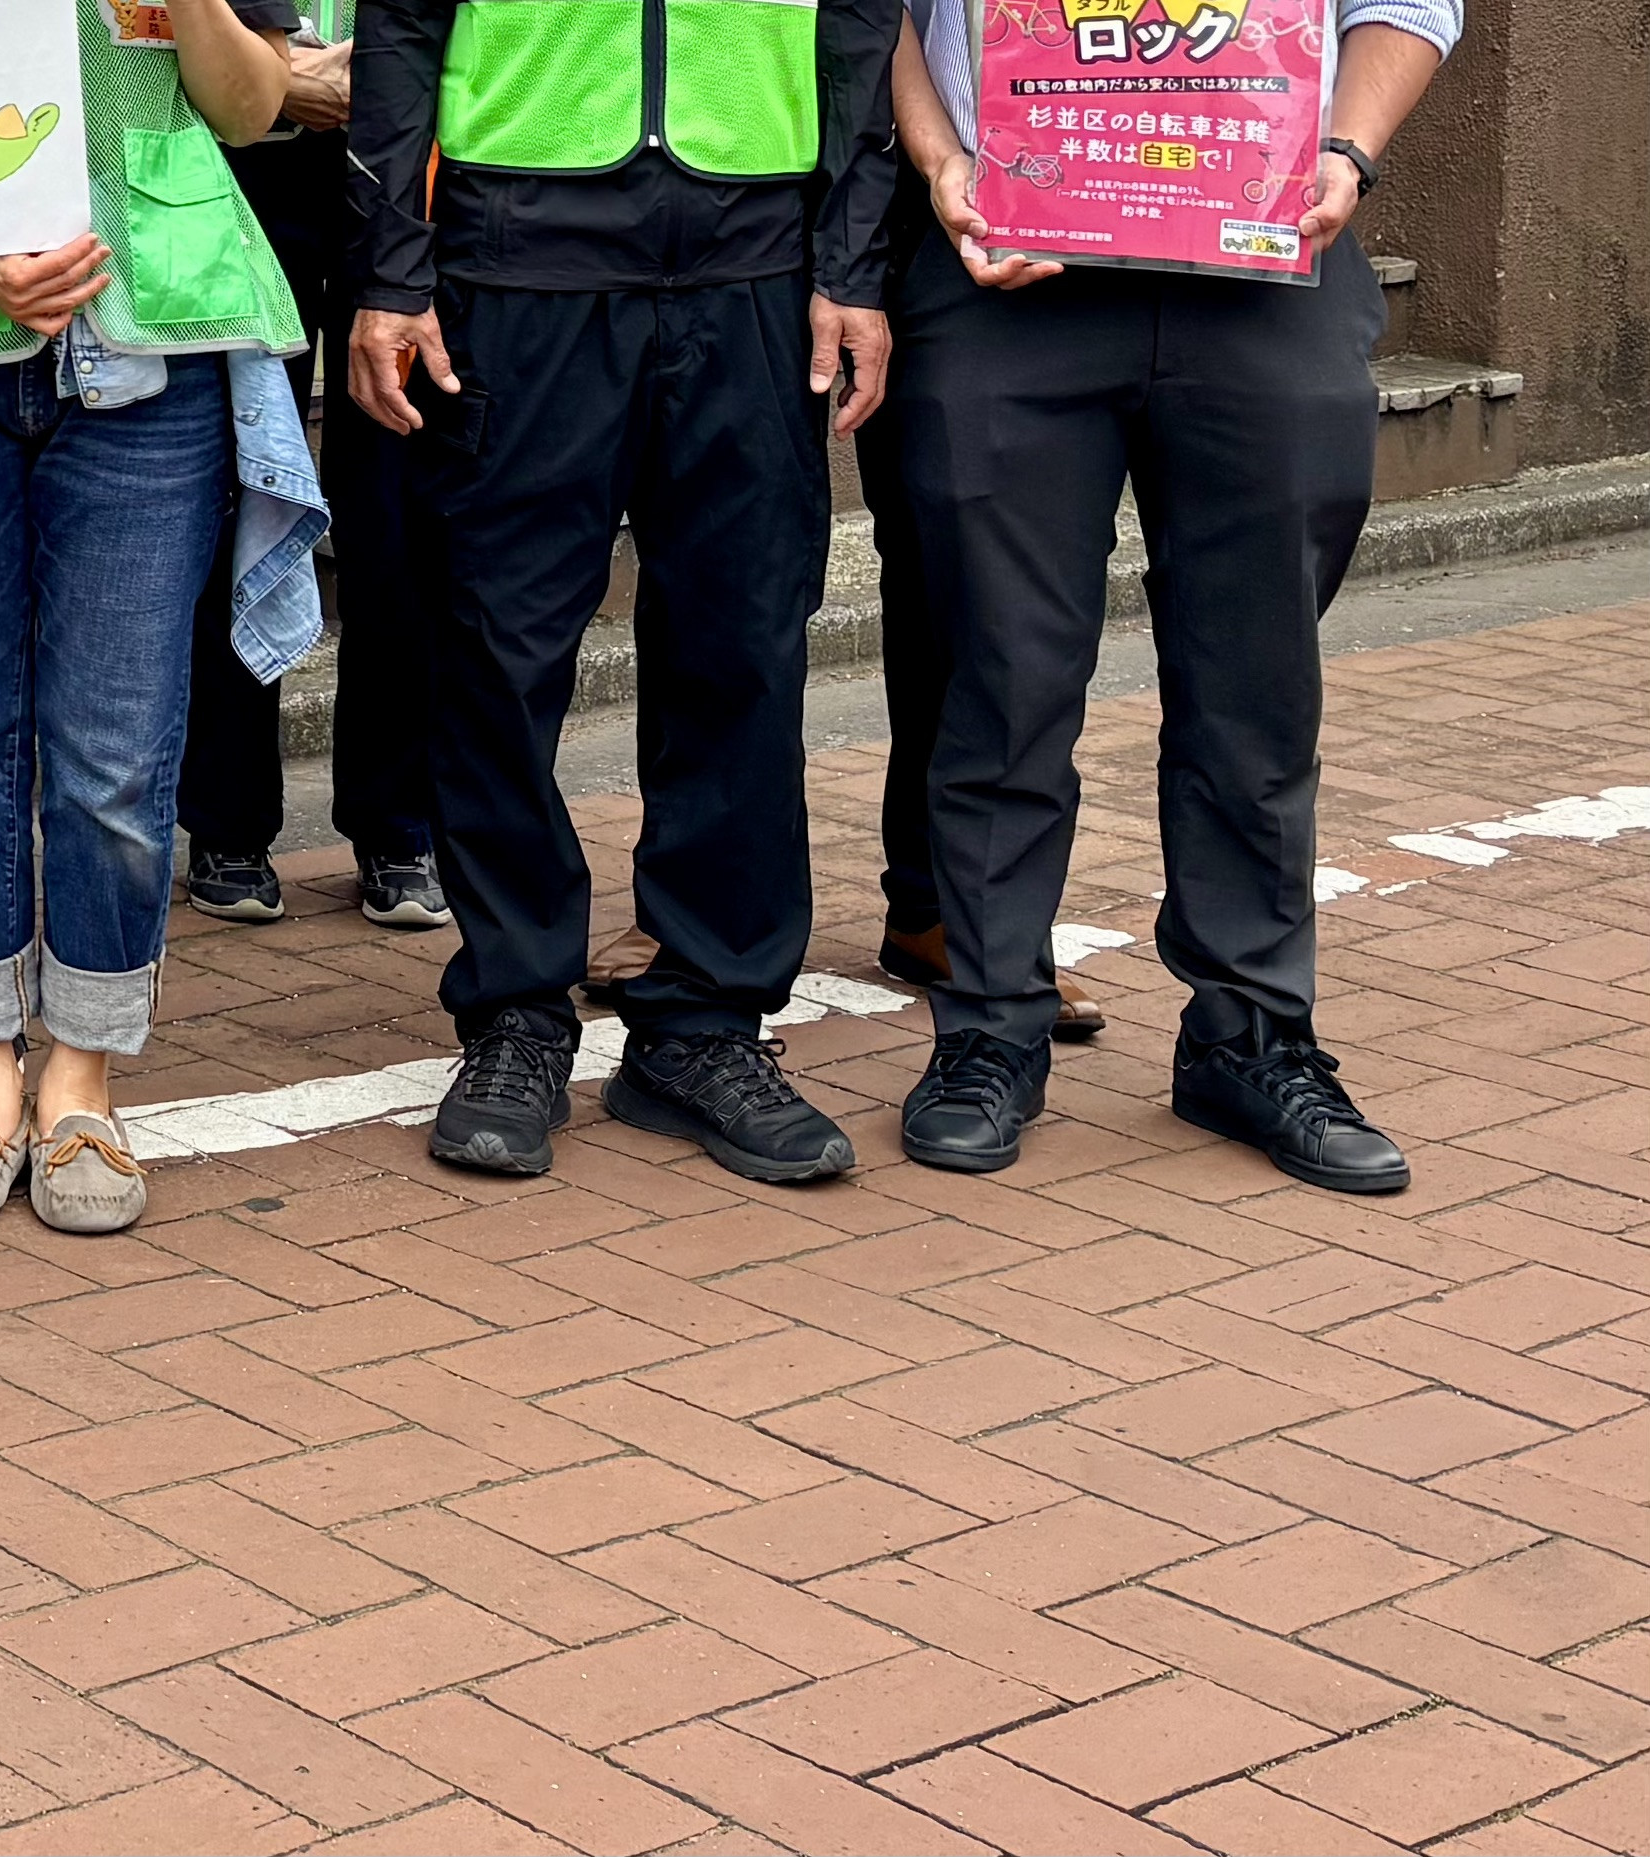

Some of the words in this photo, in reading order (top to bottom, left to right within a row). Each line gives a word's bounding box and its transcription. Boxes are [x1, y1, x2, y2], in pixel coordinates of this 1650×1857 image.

[1077, 5, 1236, 63] ロック
[1027, 104, 1271, 144] 杉並区の自転車盗難
